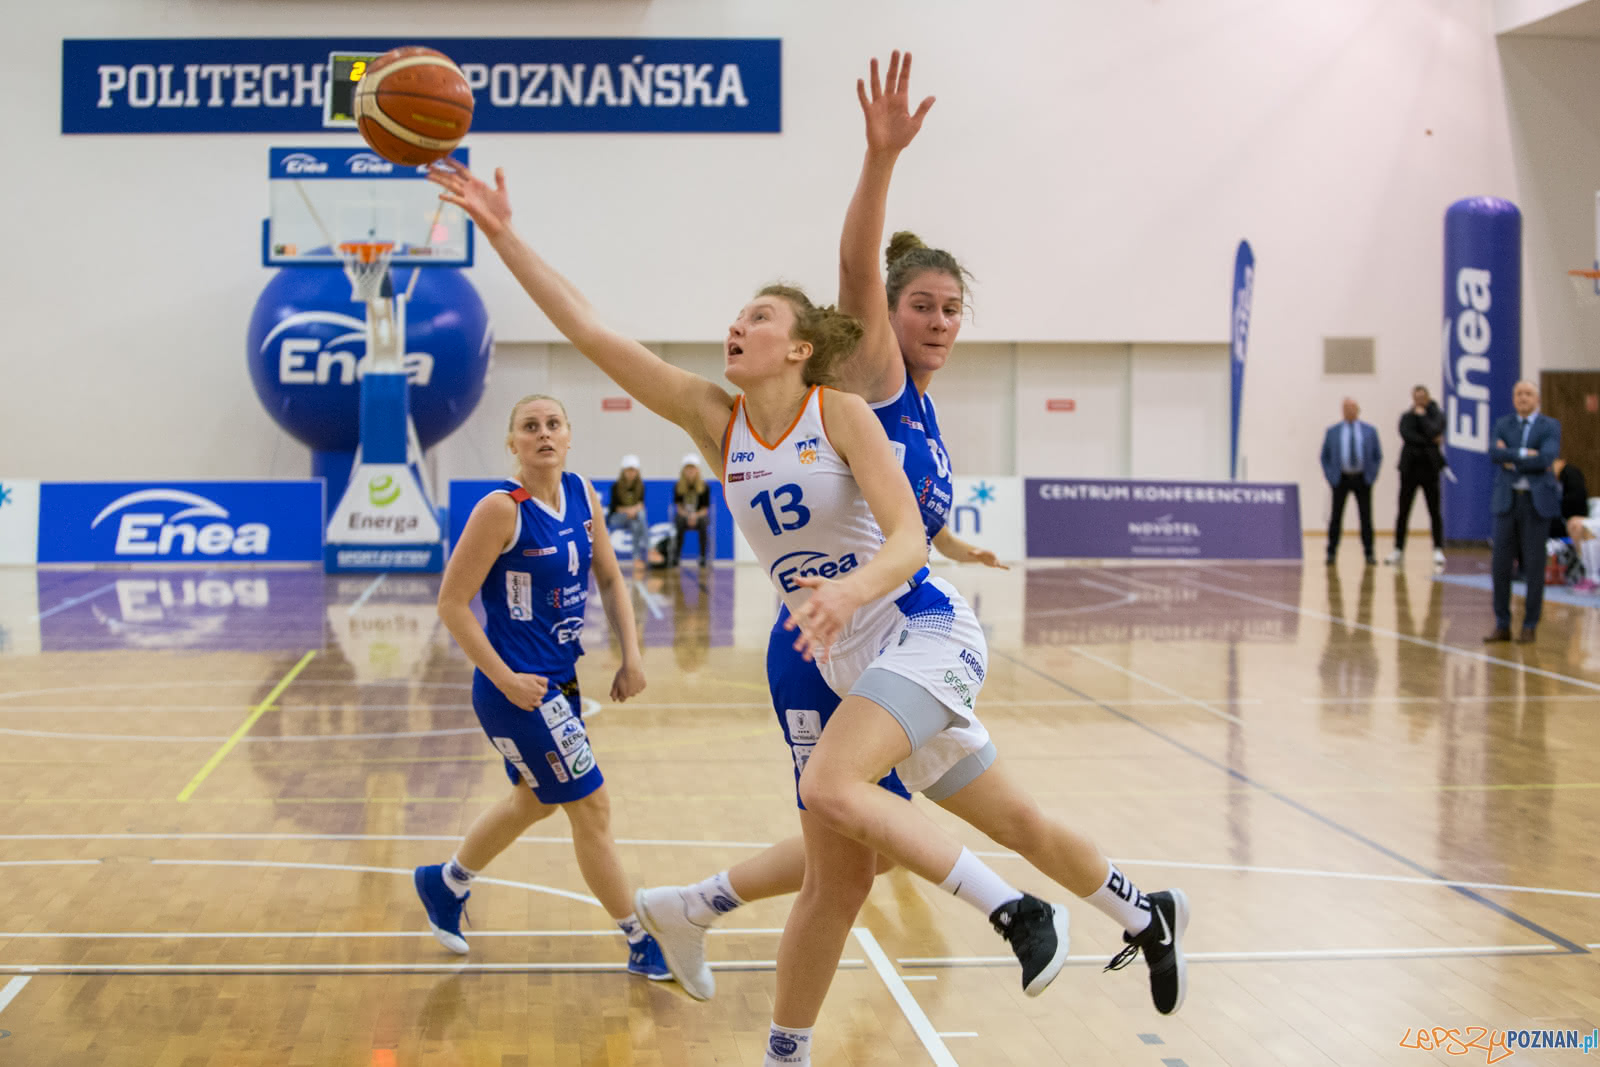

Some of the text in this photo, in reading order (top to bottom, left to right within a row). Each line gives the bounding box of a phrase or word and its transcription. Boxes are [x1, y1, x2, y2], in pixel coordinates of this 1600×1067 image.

[97, 55, 749, 108] POLITECH POZNAŃSKA
[279, 338, 434, 386] Ena
[1447, 266, 1492, 454] Enea
[750, 483, 811, 536] 13
[1039, 484, 1285, 505] CENTRUM KONFERENCYJNE
[115, 513, 270, 554] Enea
[349, 512, 418, 535] Energa
[1128, 522, 1201, 537] NOVOTEL
[567, 540, 579, 576] 4
